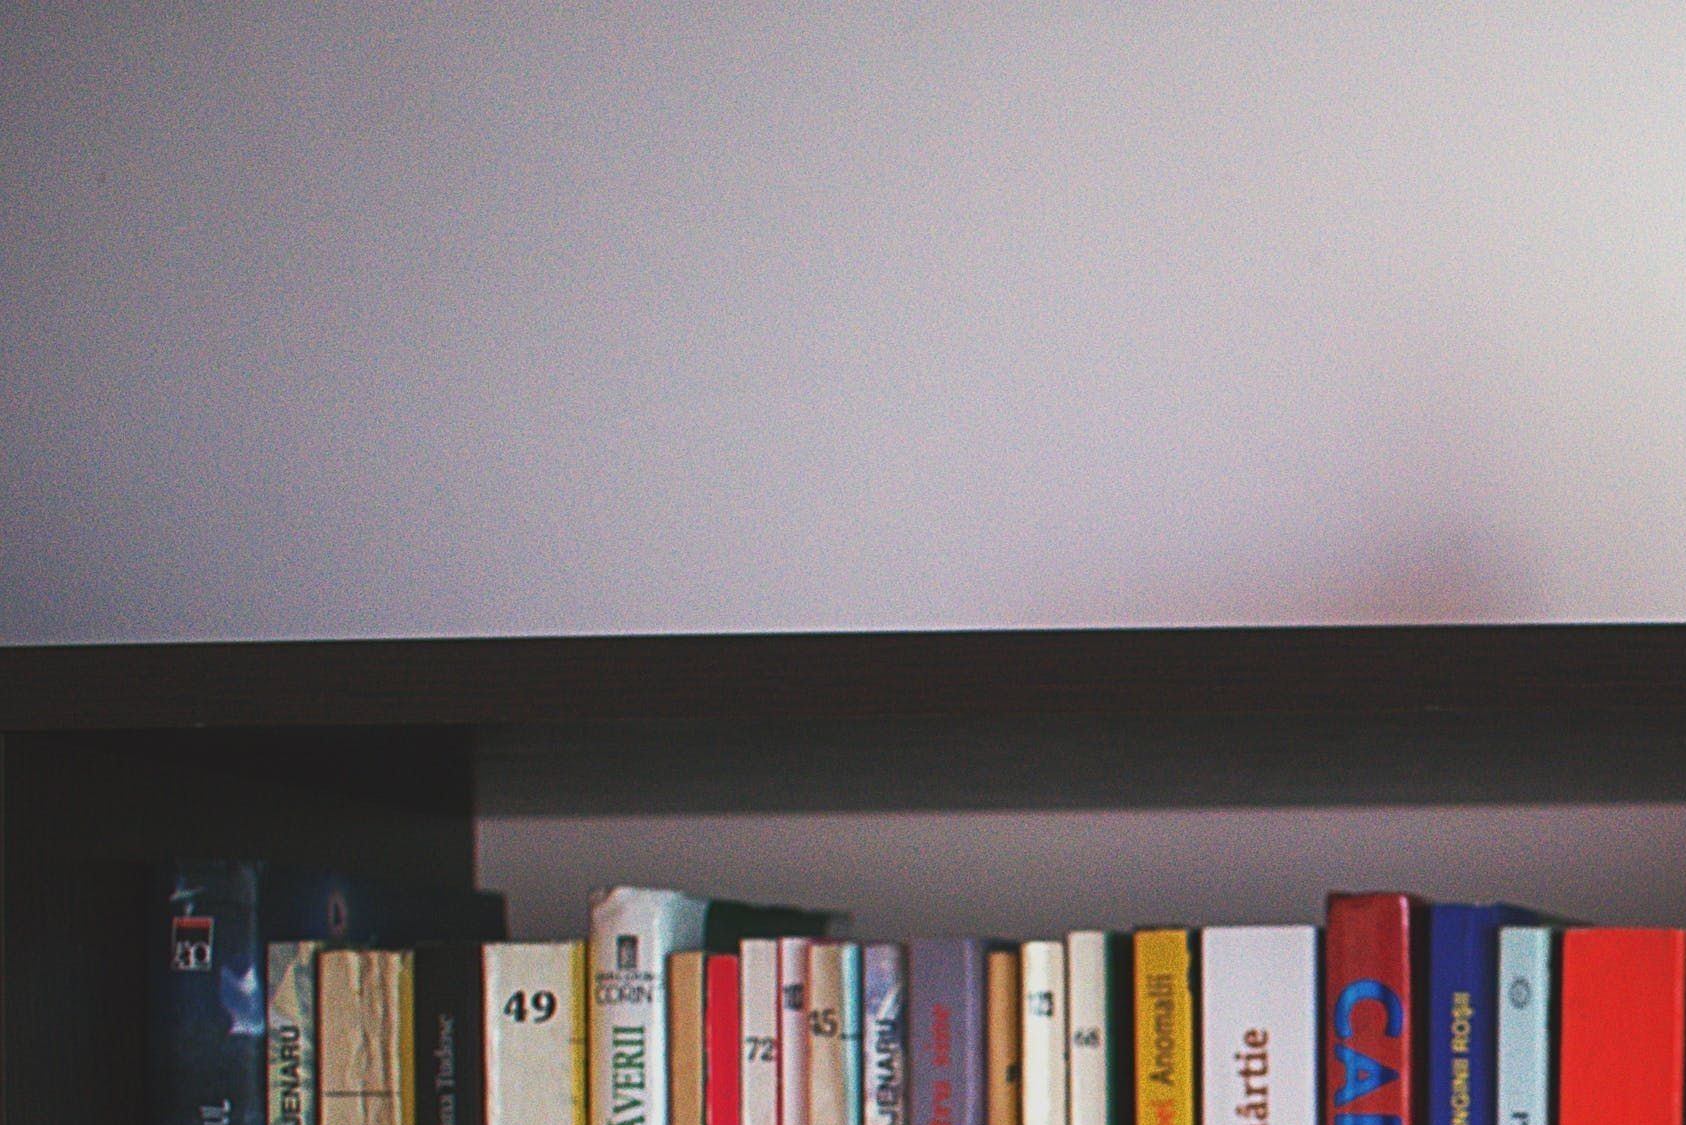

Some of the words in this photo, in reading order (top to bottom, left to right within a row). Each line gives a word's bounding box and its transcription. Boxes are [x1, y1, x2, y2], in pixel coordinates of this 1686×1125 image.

[503, 989, 558, 1024] 49
[1147, 973, 1174, 1088] Anomalii
[746, 1036, 777, 1062] 72
